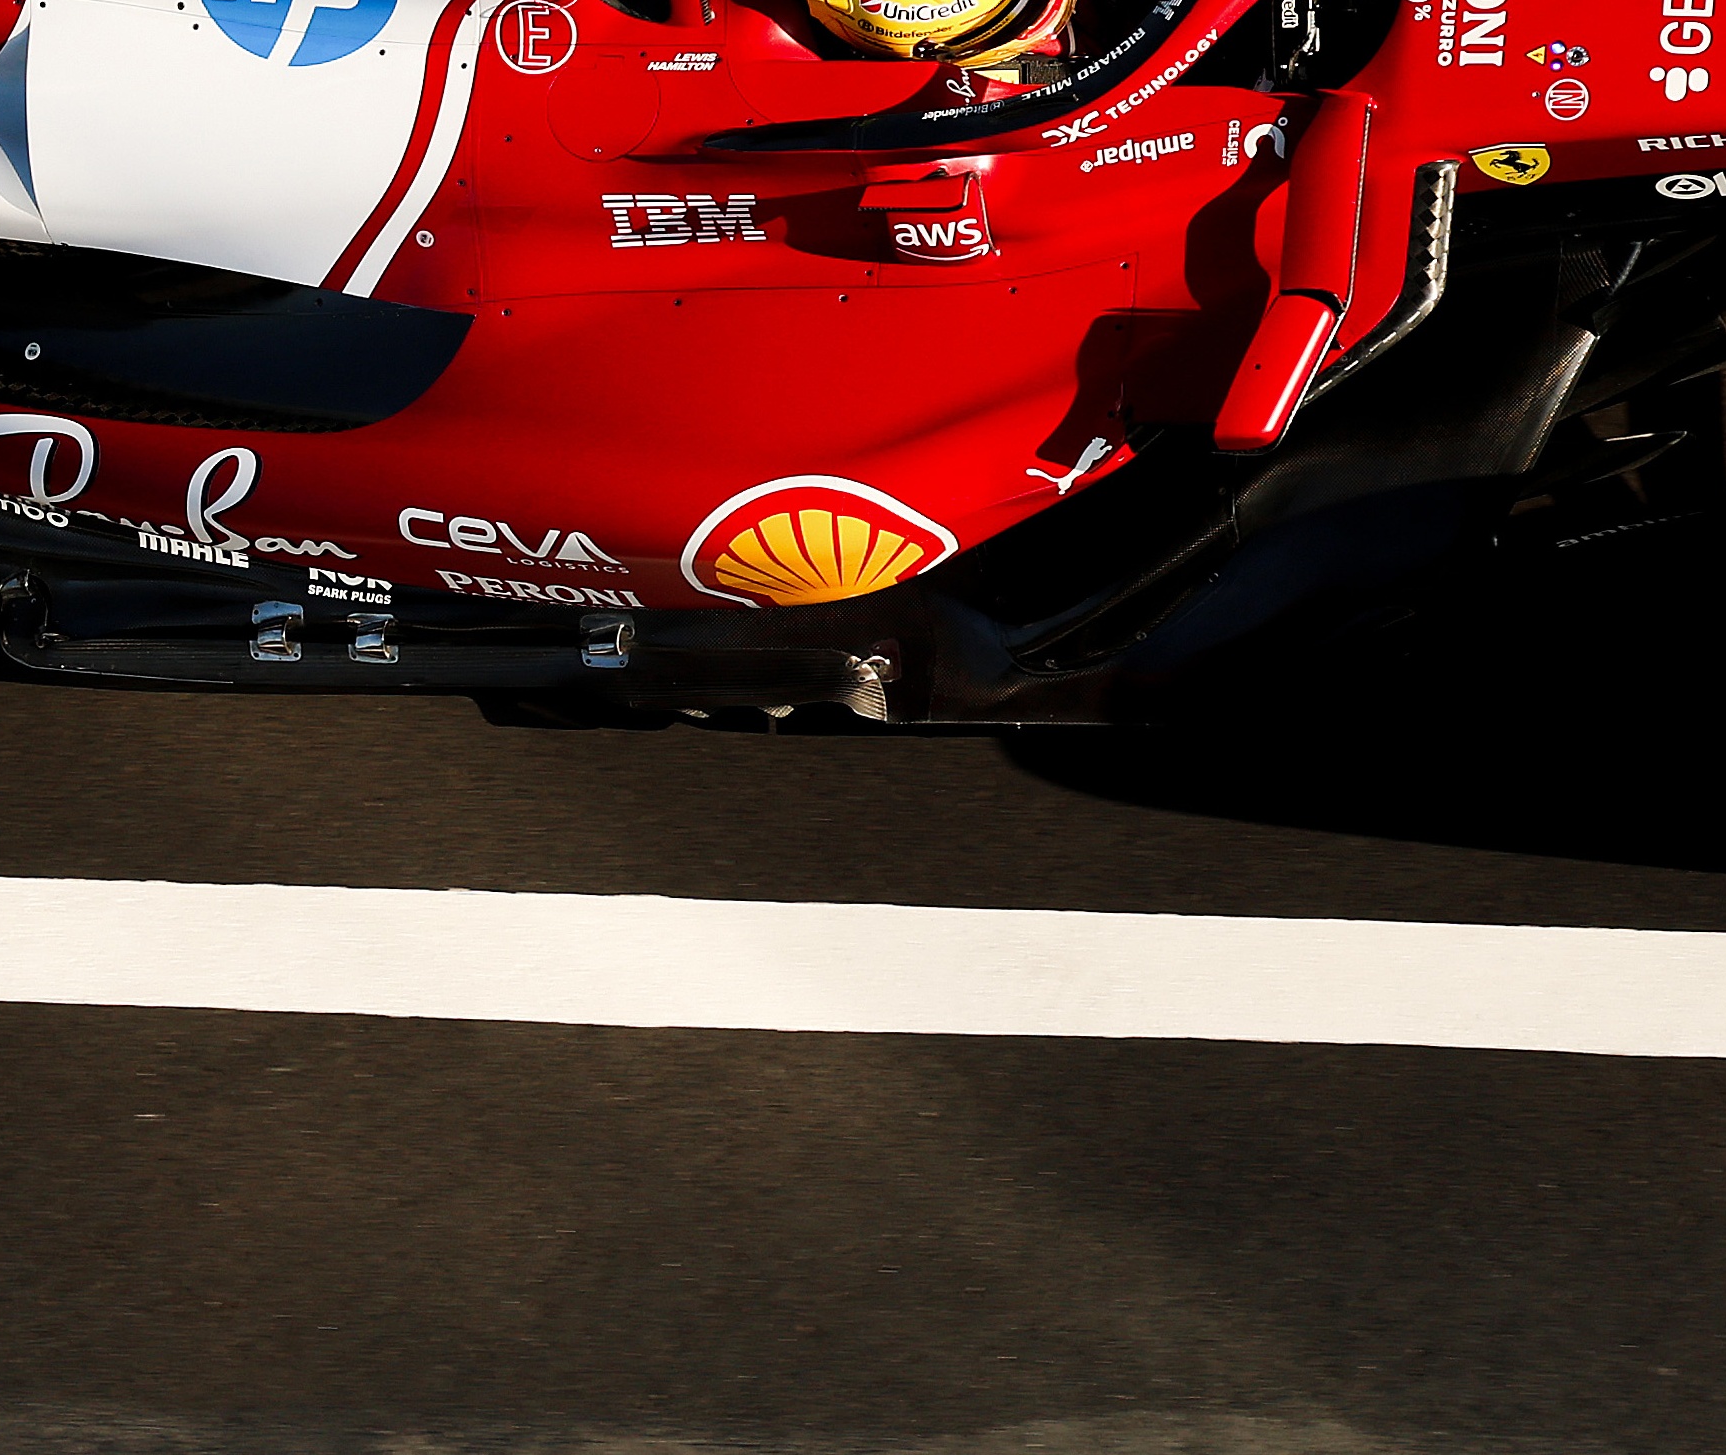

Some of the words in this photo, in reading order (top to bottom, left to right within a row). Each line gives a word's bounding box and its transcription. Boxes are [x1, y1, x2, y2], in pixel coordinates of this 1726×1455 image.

[875, 25, 954, 39] Bitdefender
[646, 61, 716, 72] HAMILTON
[674, 52, 718, 63] LEWIS
[1077, 27, 1146, 81] RICHARD
[1105, 28, 1220, 120] TECHNOLOGY
[1093, 132, 1195, 166] ambipar
[1226, 120, 1241, 167] CELSIUS
[602, 194, 767, 249] IBM
[894, 217, 985, 249] aws
[138, 531, 250, 569] MAHLE
[506, 557, 631, 574] LOGISTICS
[307, 584, 349, 601] SPARK
[350, 590, 393, 606] PLUGS
[434, 569, 646, 609] PERONI
